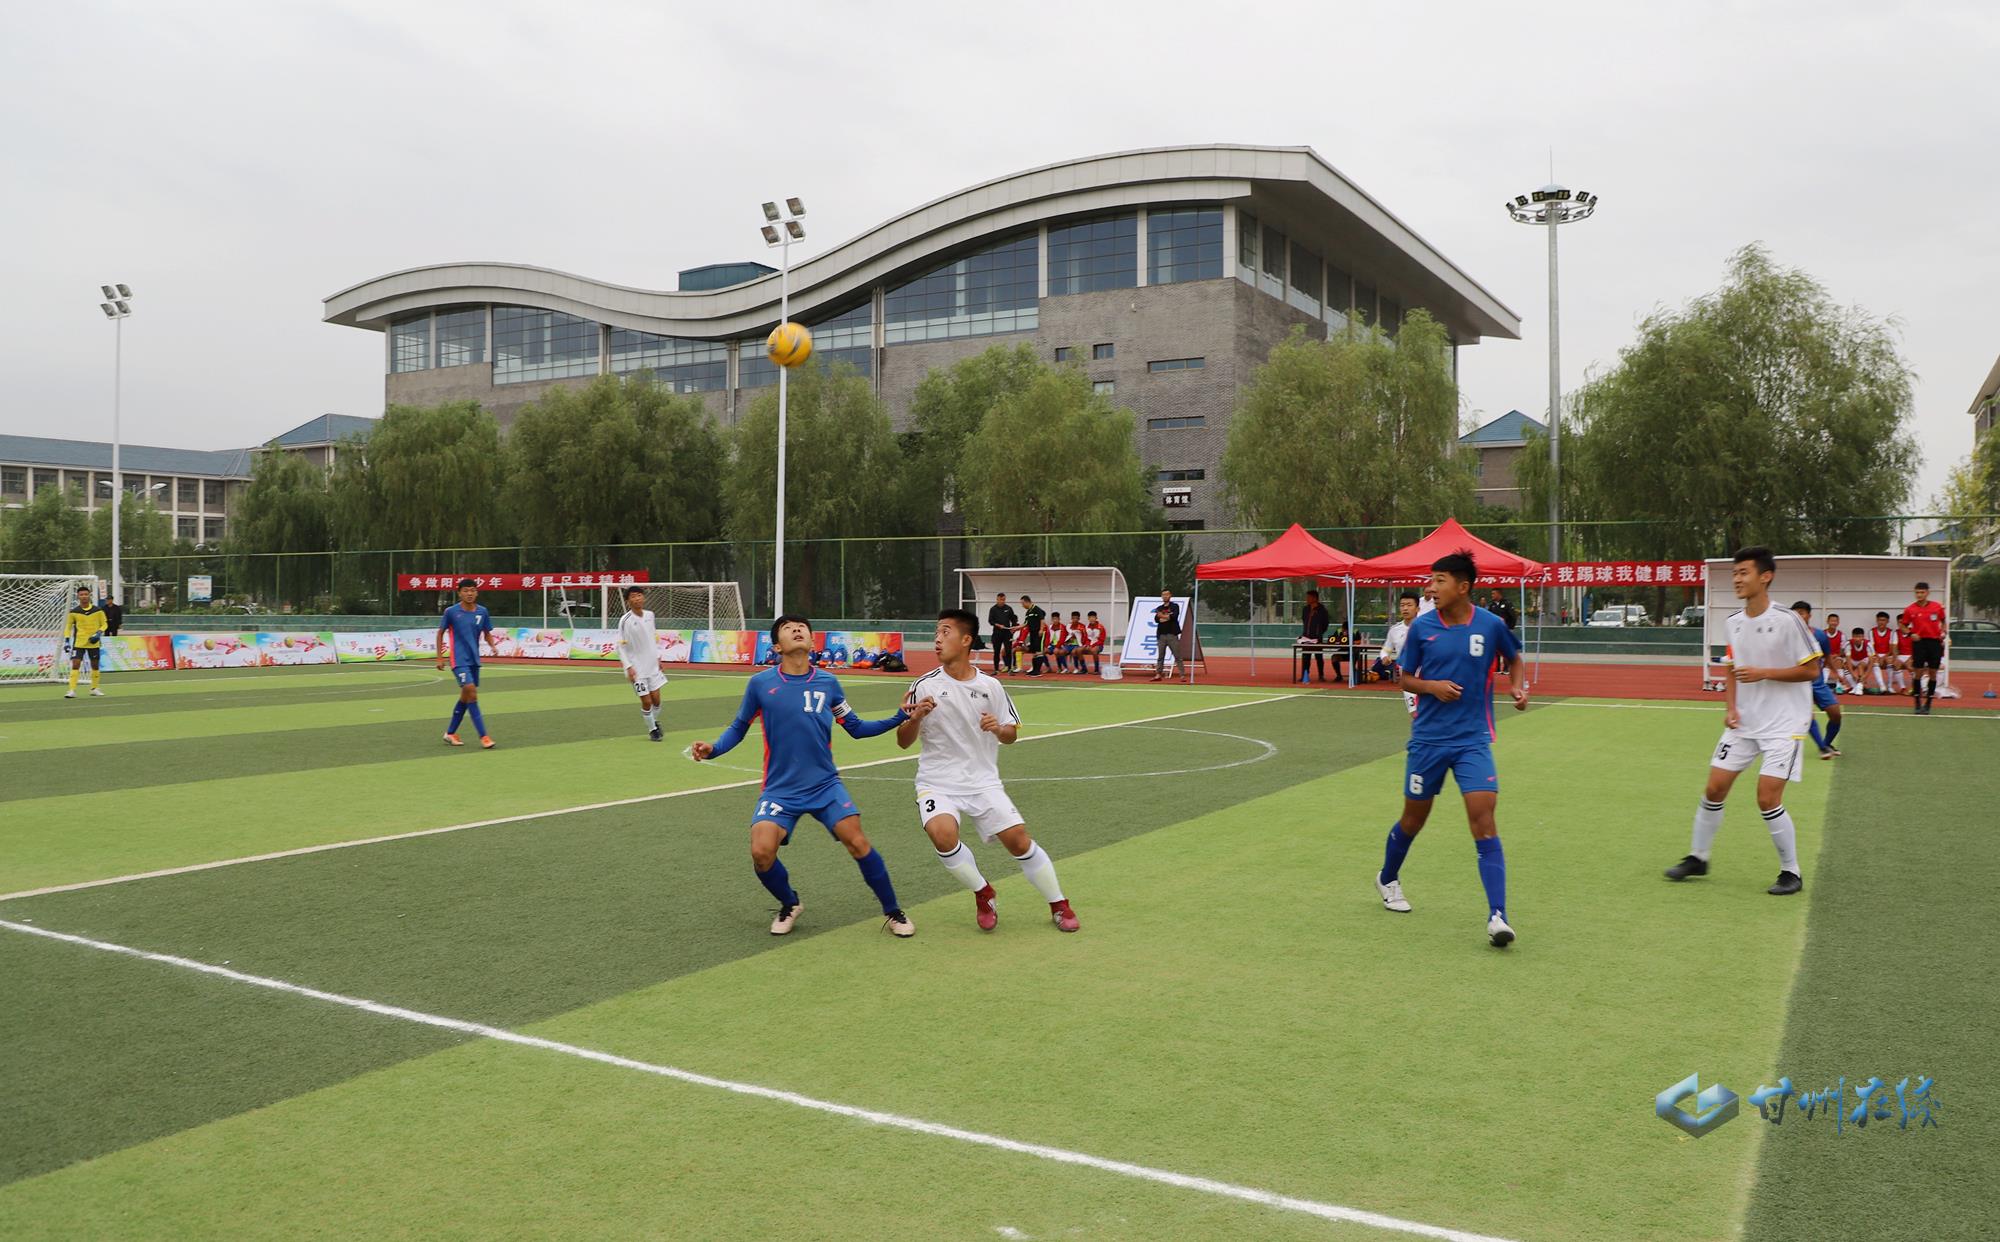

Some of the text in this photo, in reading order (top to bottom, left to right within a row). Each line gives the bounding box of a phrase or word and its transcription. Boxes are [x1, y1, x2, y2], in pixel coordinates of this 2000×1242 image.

[475, 615, 482, 624] 7
[1469, 634, 1485, 657] 6
[459, 673, 466, 682] 7
[803, 690, 826, 713] 17
[1409, 774, 1424, 795] 6
[757, 800, 784, 817] 17
[925, 799, 936, 813] 3
